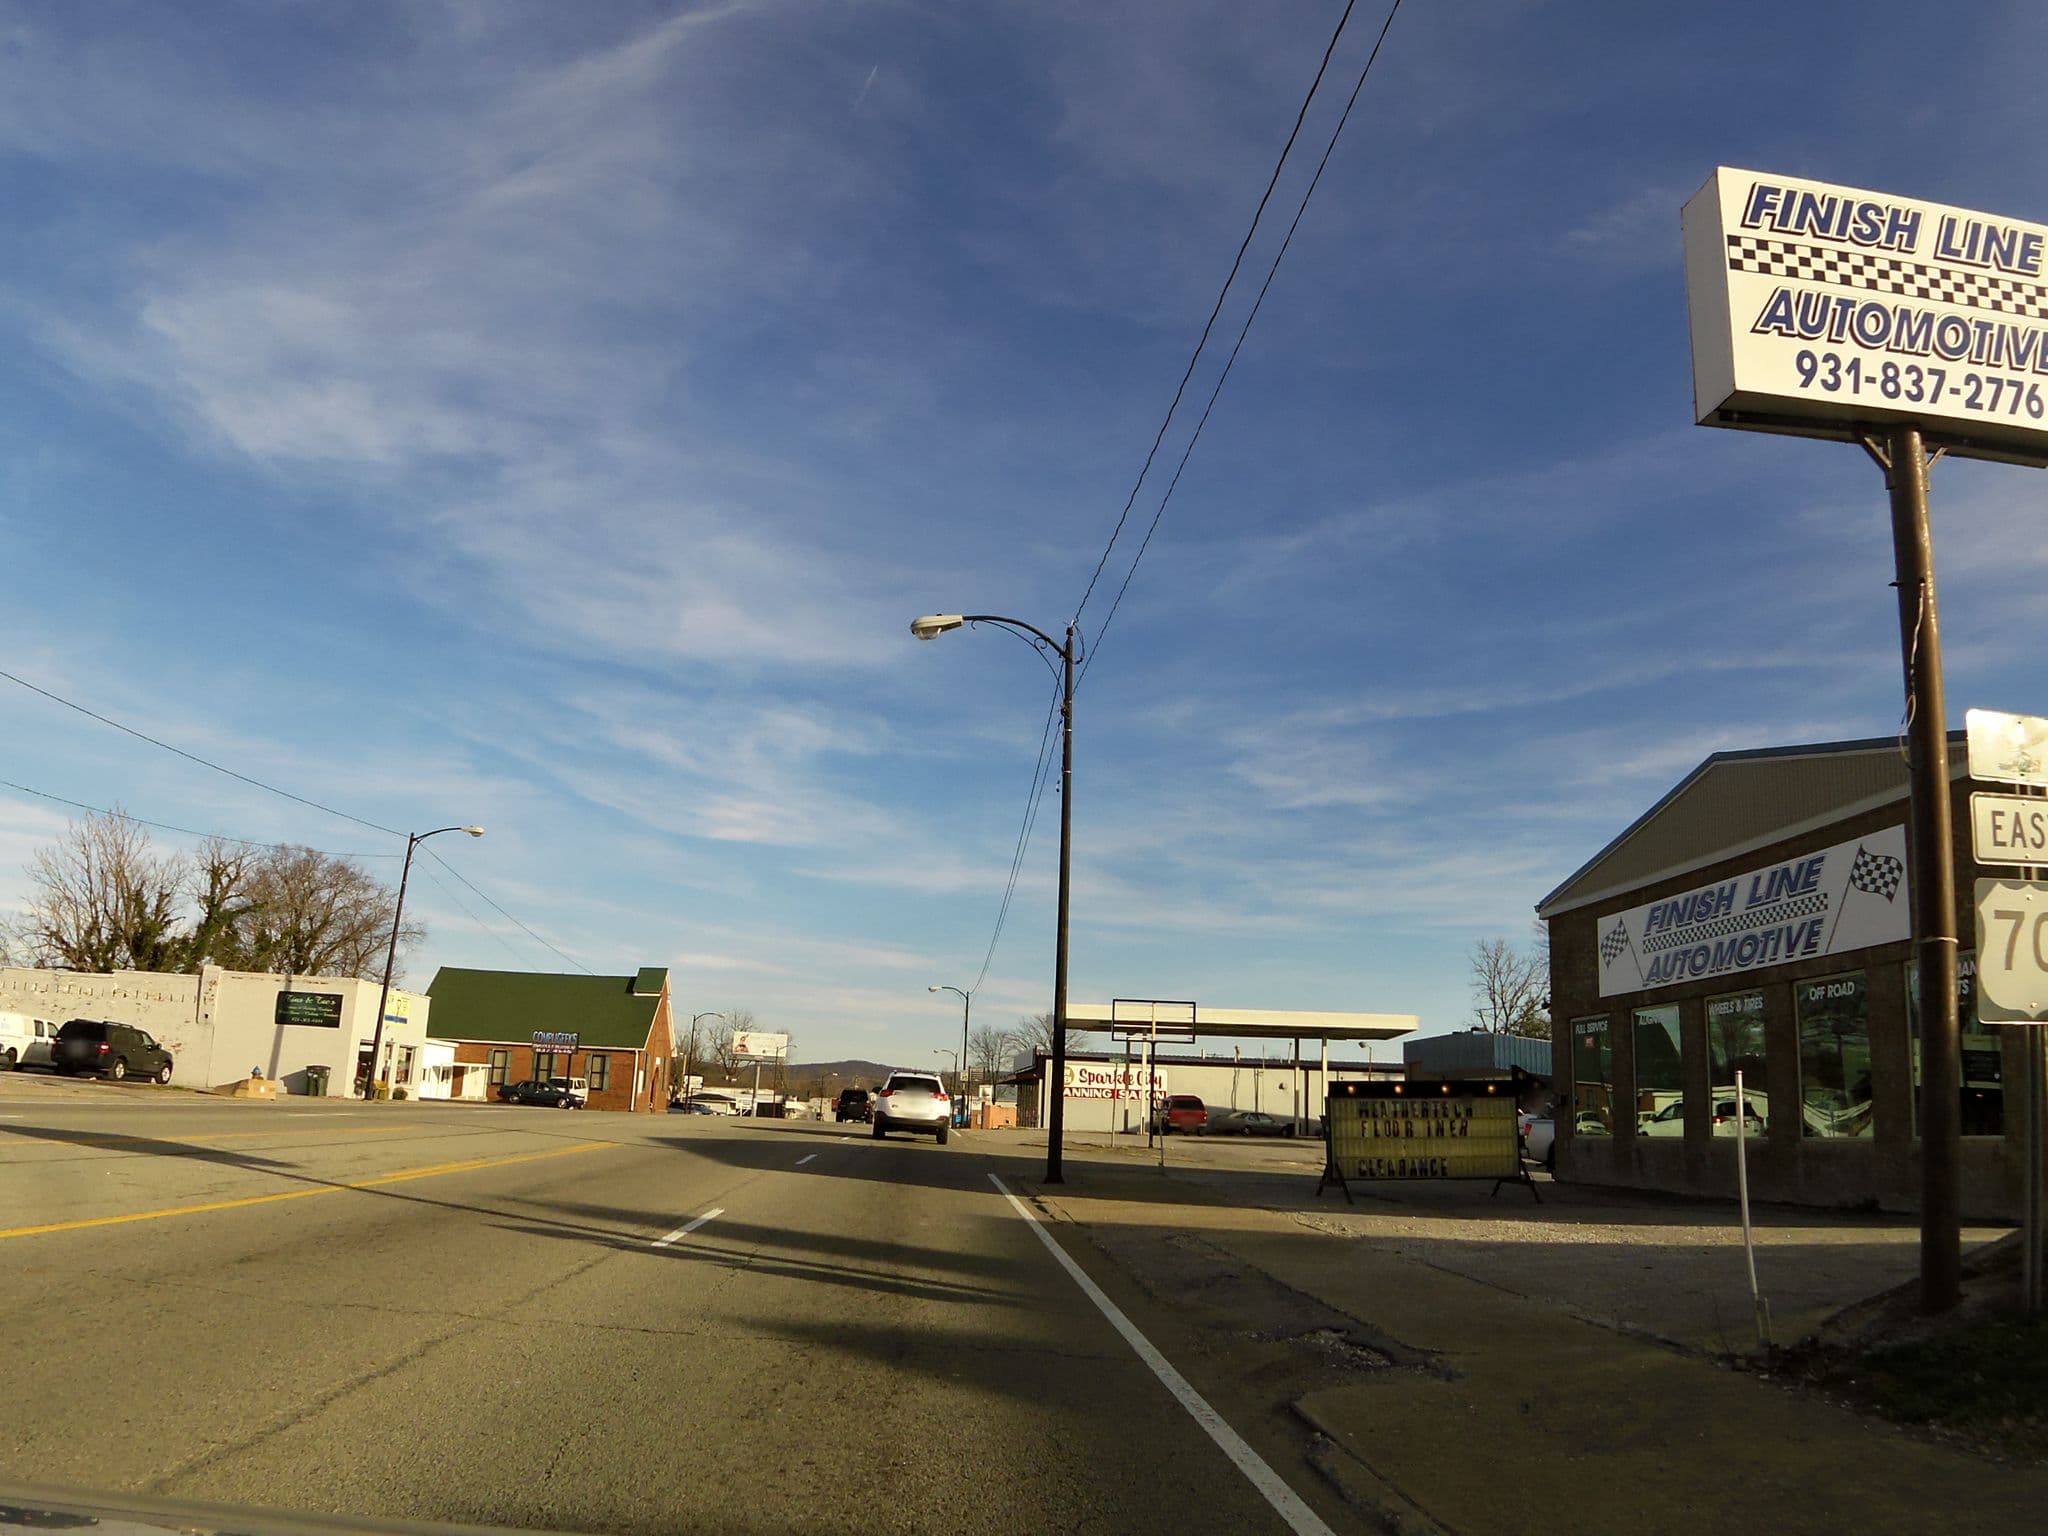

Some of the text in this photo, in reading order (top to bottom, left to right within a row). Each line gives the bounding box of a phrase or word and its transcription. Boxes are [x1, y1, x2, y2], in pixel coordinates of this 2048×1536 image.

[1741, 181, 2047, 278] FINISH LINE
[1795, 349, 2045, 420] 931-837-2776
[1991, 809, 2048, 850] EAS
[1643, 853, 1827, 937] FINISH LINE
[1641, 917, 1825, 988] AUTOMOTIVE
[1744, 996, 1764, 1010] TIRES
[1809, 982, 1855, 1001] OFF ROAD
[1063, 1088, 1112, 1099] ANNING
[1361, 1119, 1414, 1138] FLOOR
[1357, 1157, 1450, 1177] CLEARANCE
